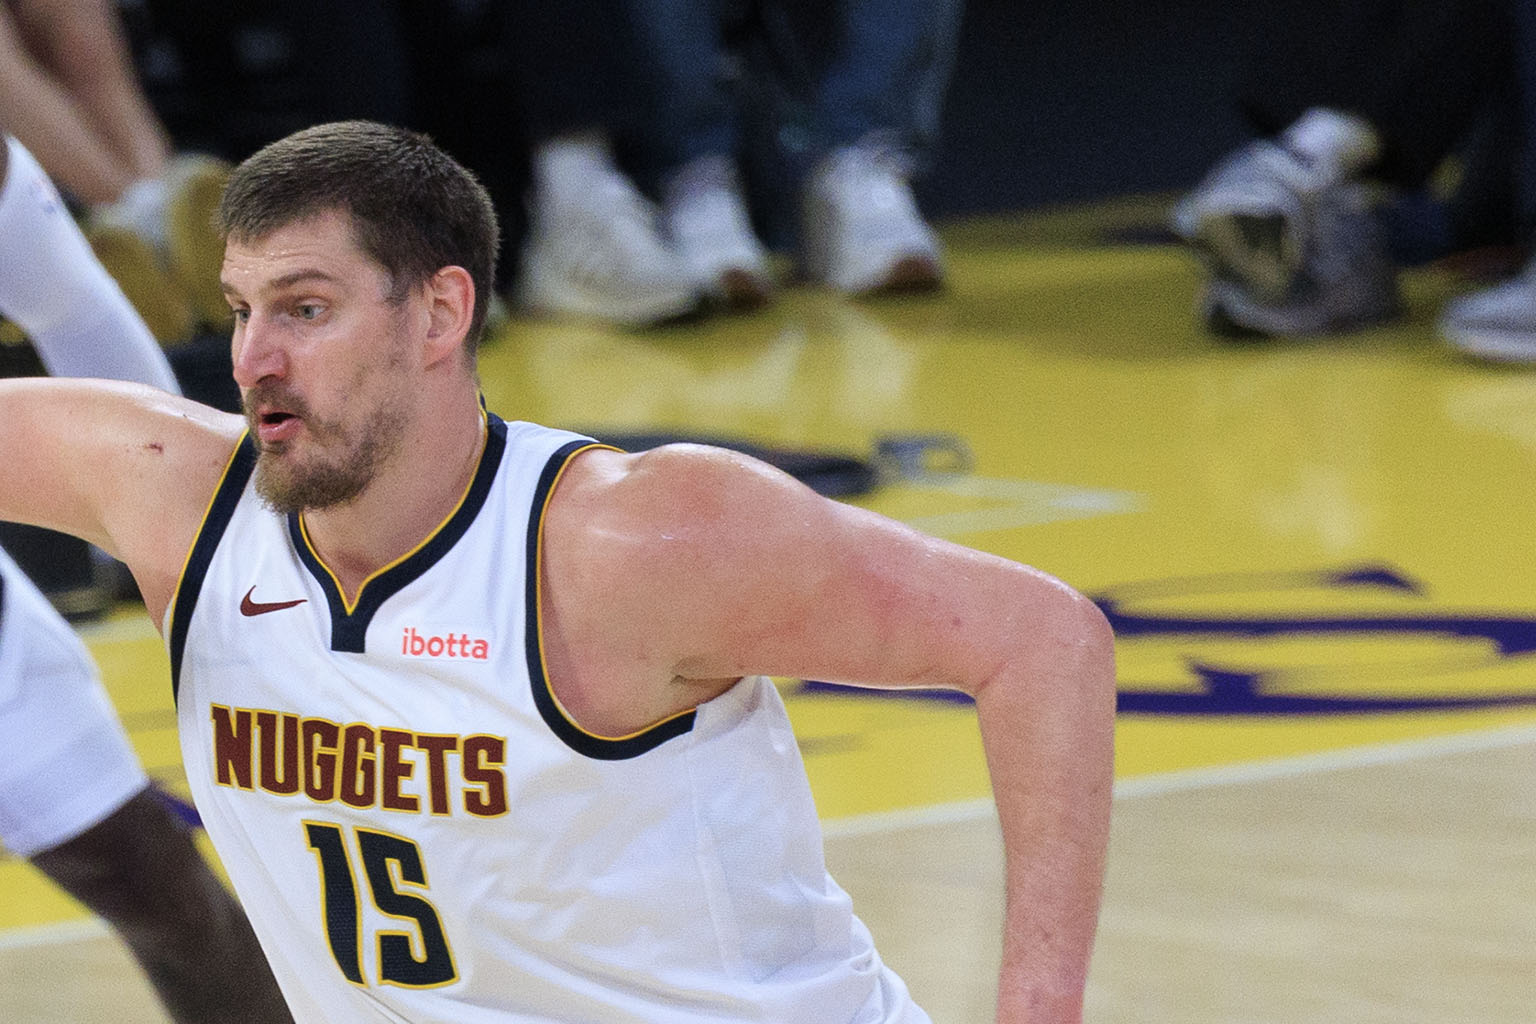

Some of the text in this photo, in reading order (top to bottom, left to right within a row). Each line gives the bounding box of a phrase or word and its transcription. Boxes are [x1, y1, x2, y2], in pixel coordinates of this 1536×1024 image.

[402, 628, 489, 660] ibotta
[210, 703, 511, 819] NUGGETS
[301, 818, 461, 990] 15
